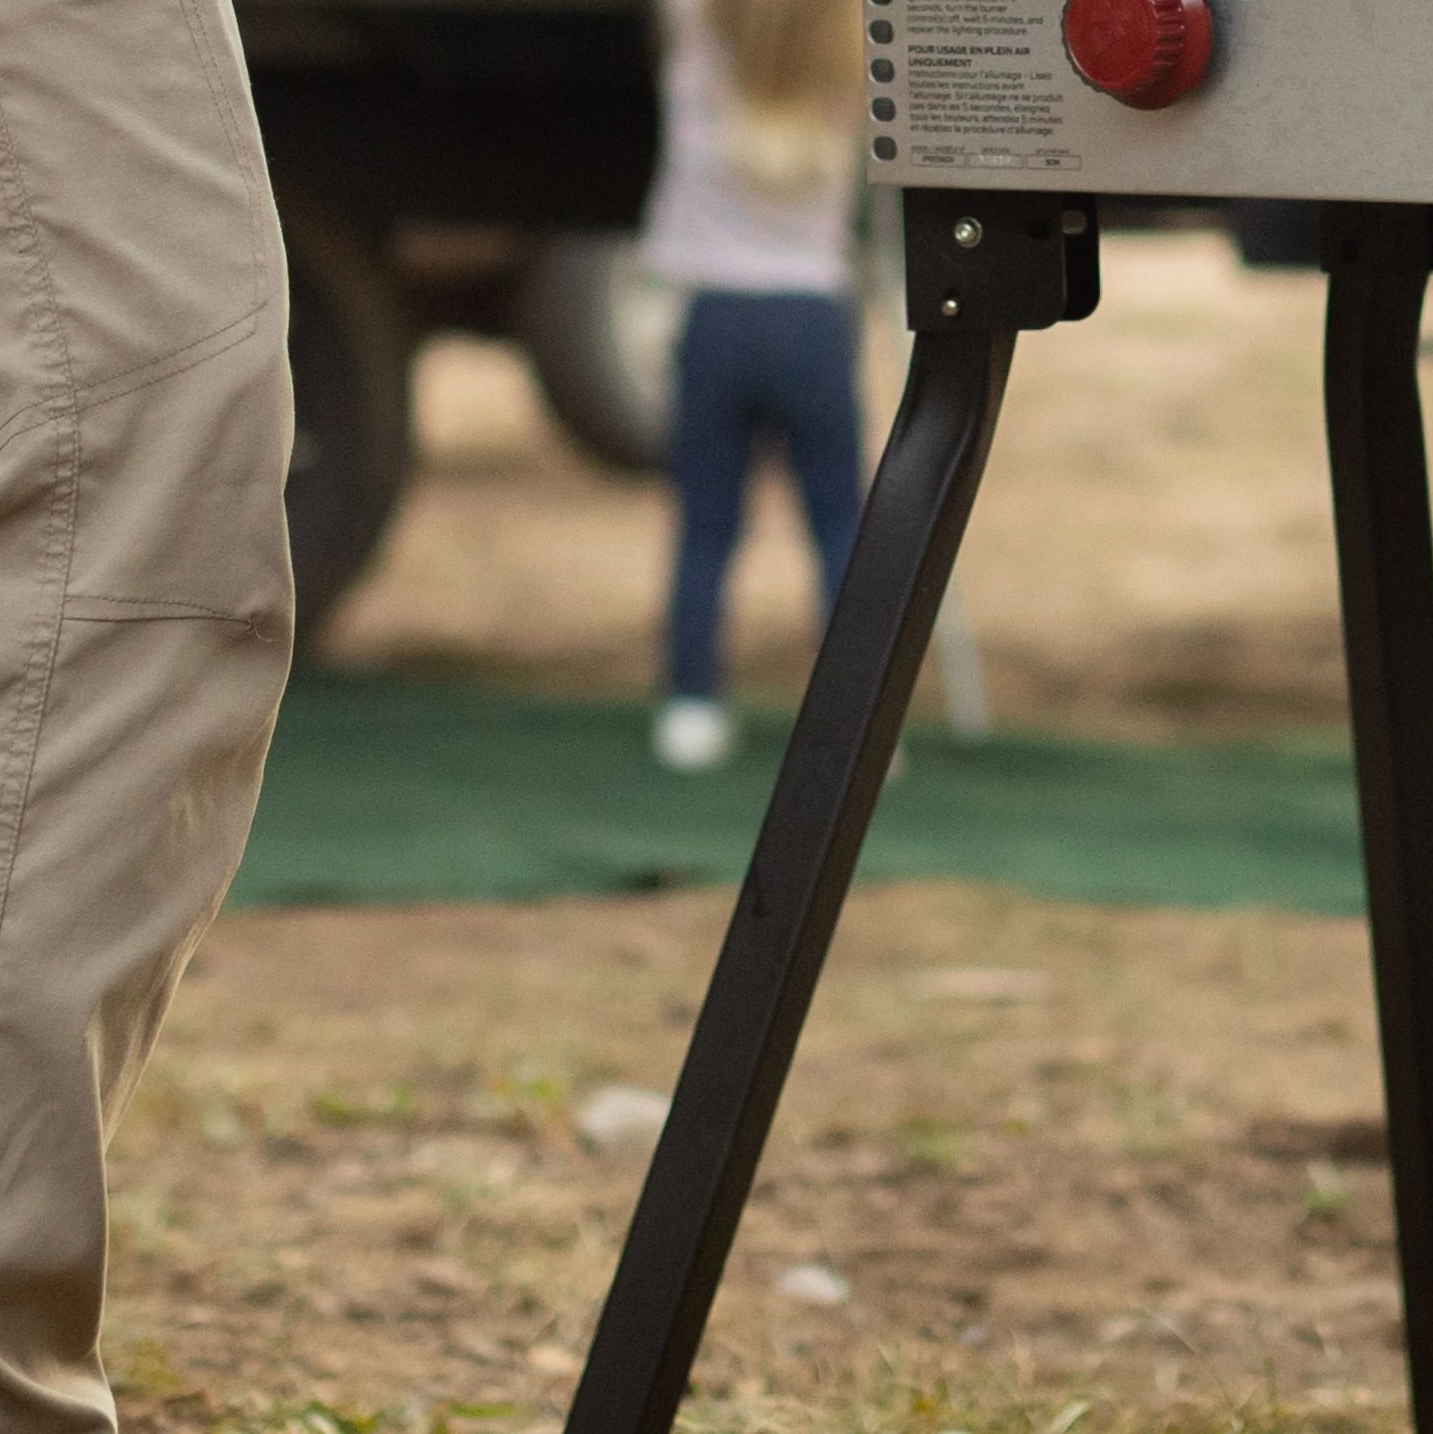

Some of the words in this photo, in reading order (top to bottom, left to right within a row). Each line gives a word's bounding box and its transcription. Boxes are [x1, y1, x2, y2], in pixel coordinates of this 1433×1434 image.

[908, 45, 935, 54] POUR
[937, 45, 967, 55] USAGE
[970, 46, 984, 55] EN
[984, 46, 1012, 55] PLEIN
[1014, 47, 1030, 55] AIR
[908, 59, 972, 68] UNIQUEMENT
